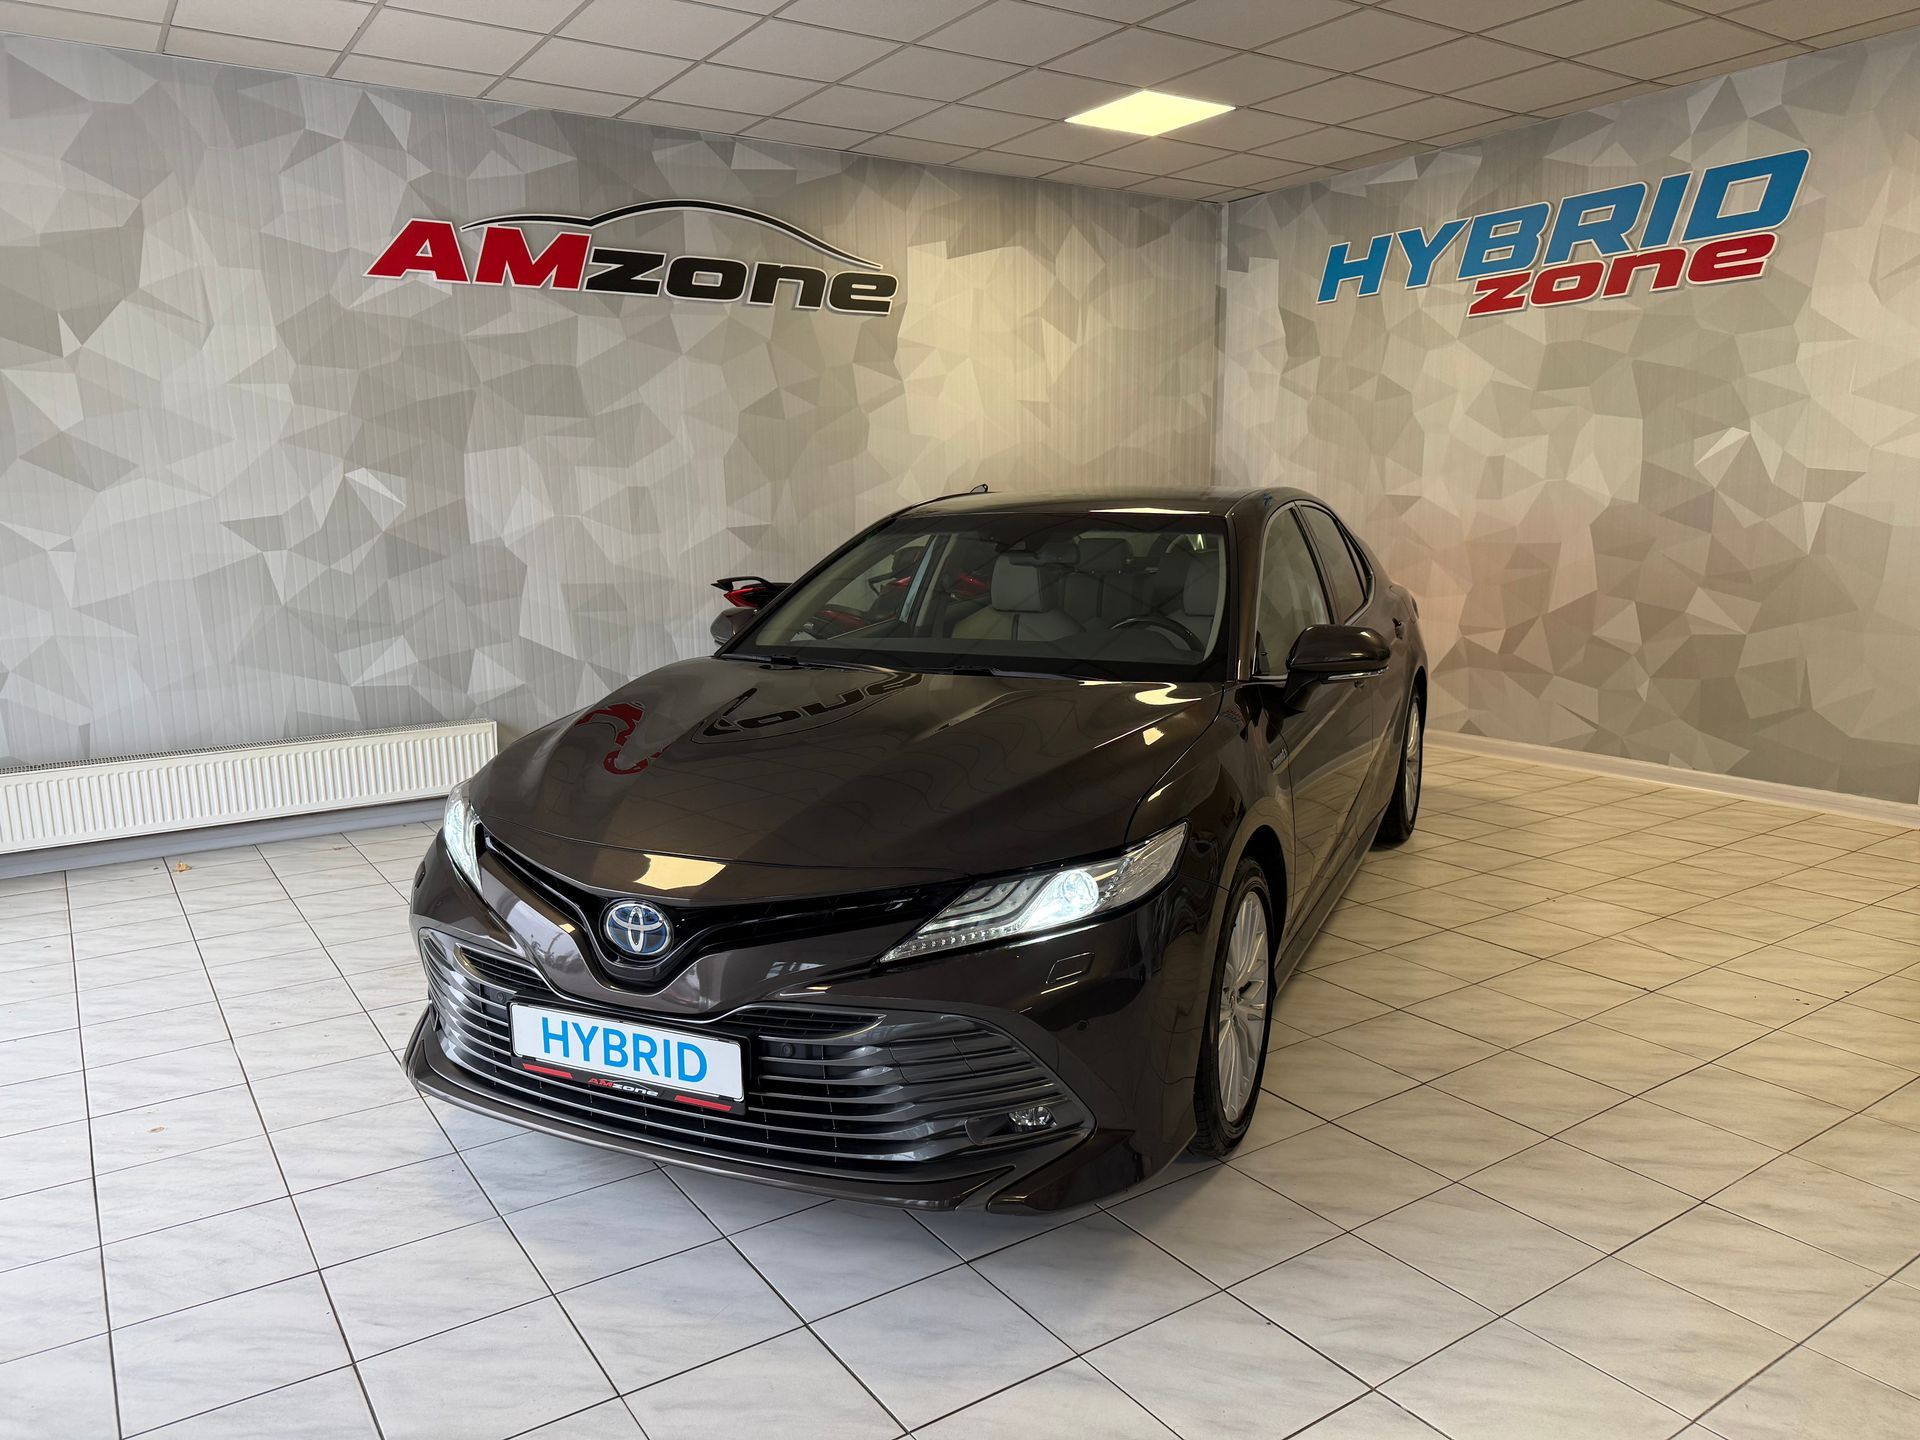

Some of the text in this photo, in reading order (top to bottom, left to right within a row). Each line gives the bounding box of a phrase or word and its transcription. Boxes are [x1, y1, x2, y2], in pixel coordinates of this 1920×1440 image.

[363, 218, 898, 315] AMzone
[1316, 148, 1811, 304] HYBRID
[1466, 233, 1778, 317] zone
[541, 1016, 708, 1083] HYBRID
[587, 1077, 659, 1097] AMzone
